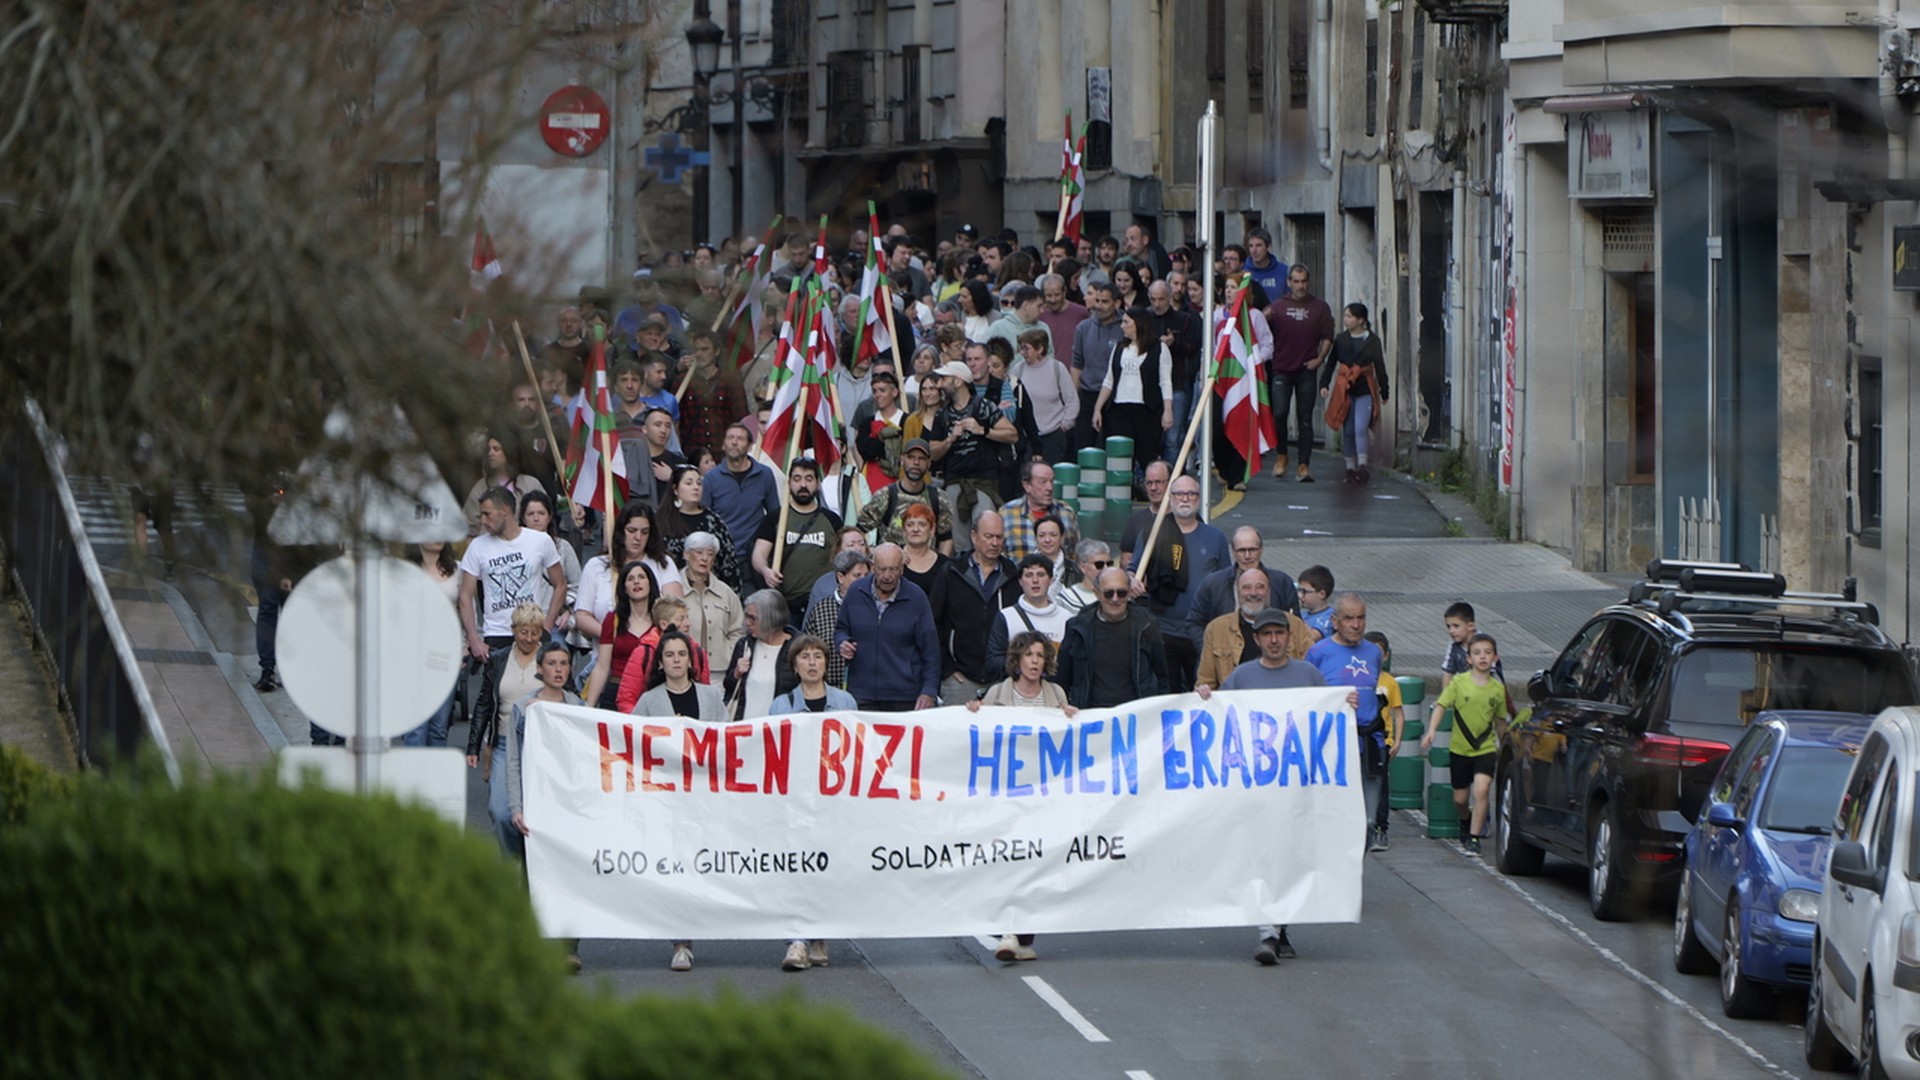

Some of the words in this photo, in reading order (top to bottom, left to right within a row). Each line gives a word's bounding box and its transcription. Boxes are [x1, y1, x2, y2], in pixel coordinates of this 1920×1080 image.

[597, 720, 792, 795] HEMEN
[968, 713, 1139, 796] HEMEN
[1160, 704, 1348, 790] ERABAKI
[592, 849, 648, 875] 1500
[870, 838, 1044, 872] SOLDATAREN
[1065, 834, 1127, 865] ALDE
